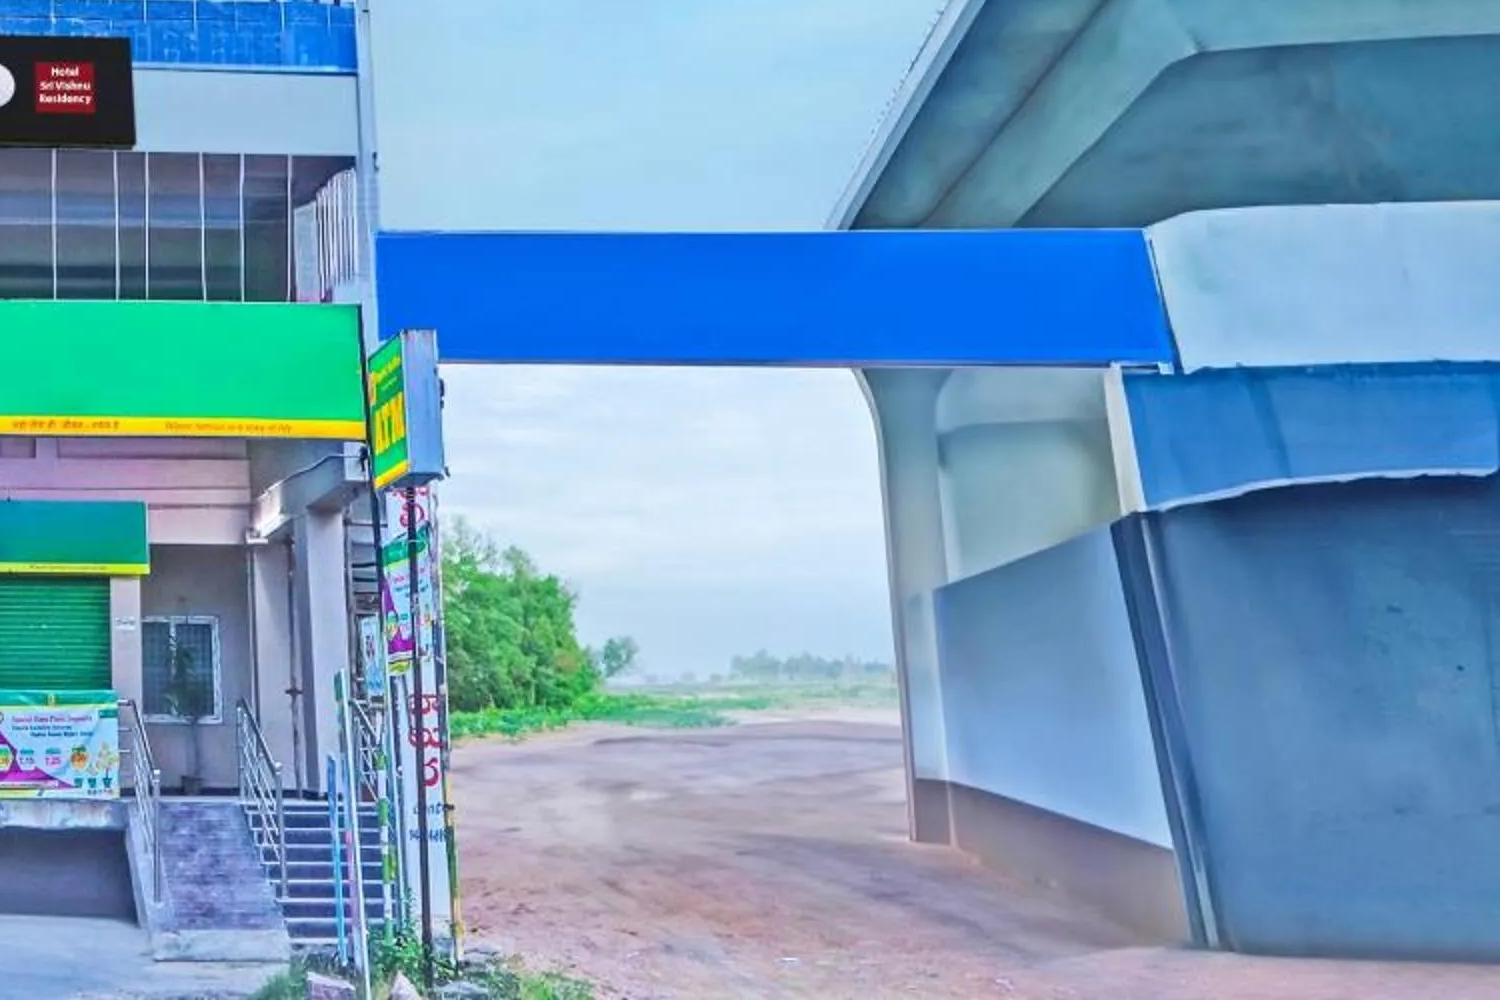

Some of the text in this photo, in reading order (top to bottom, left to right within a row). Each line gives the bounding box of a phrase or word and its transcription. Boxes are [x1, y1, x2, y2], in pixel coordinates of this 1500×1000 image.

[51, 66, 80, 77] Hotel
[39, 93, 92, 104] Residency
[375, 391, 406, 456] ATM
